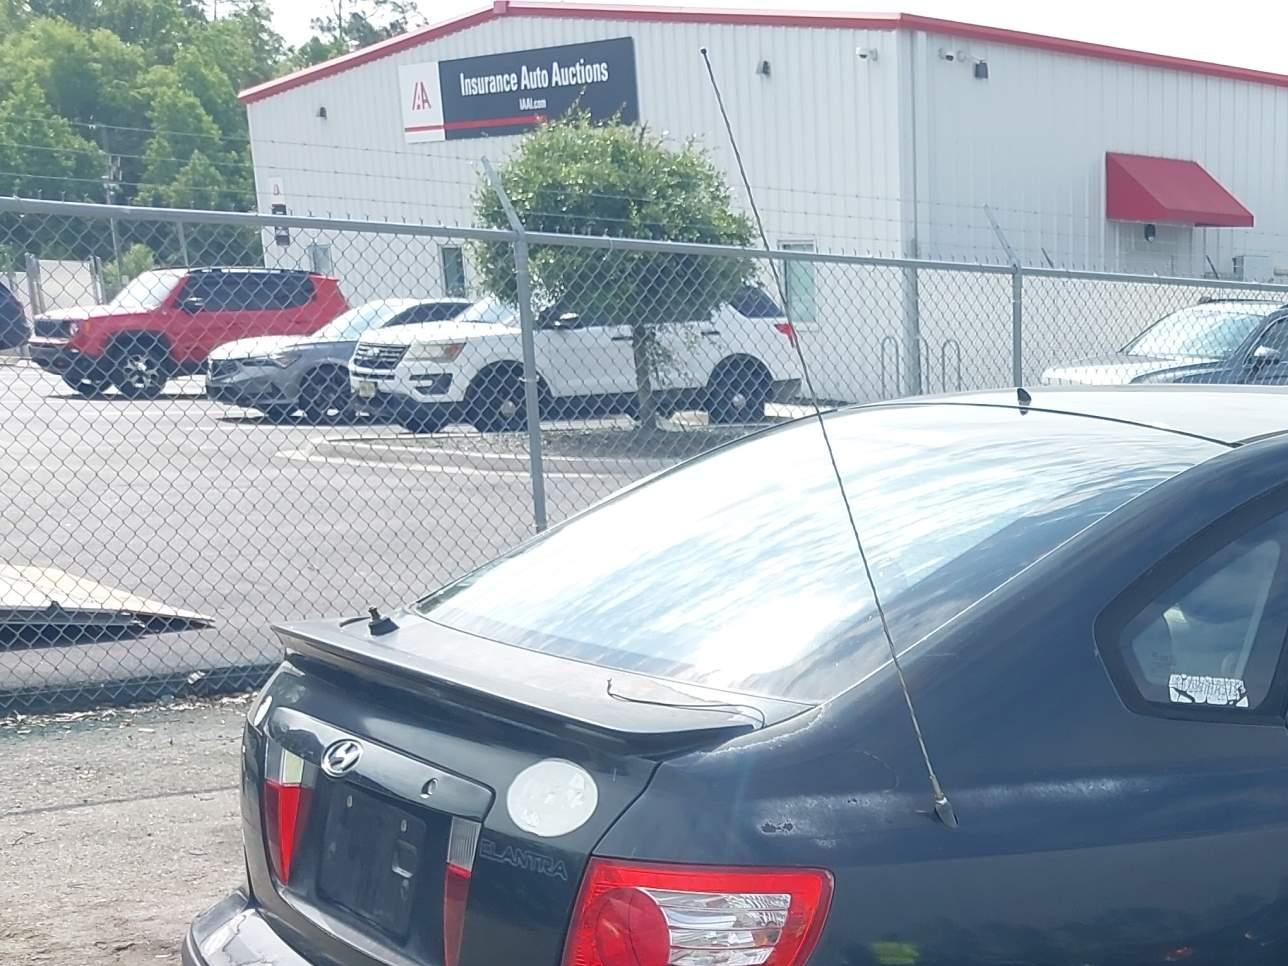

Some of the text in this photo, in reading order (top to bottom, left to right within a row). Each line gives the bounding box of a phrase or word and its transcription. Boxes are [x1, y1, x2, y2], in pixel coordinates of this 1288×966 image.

[460, 58, 609, 97] Insurance Auto Auctions
[480, 838, 568, 880] ELANTRA
